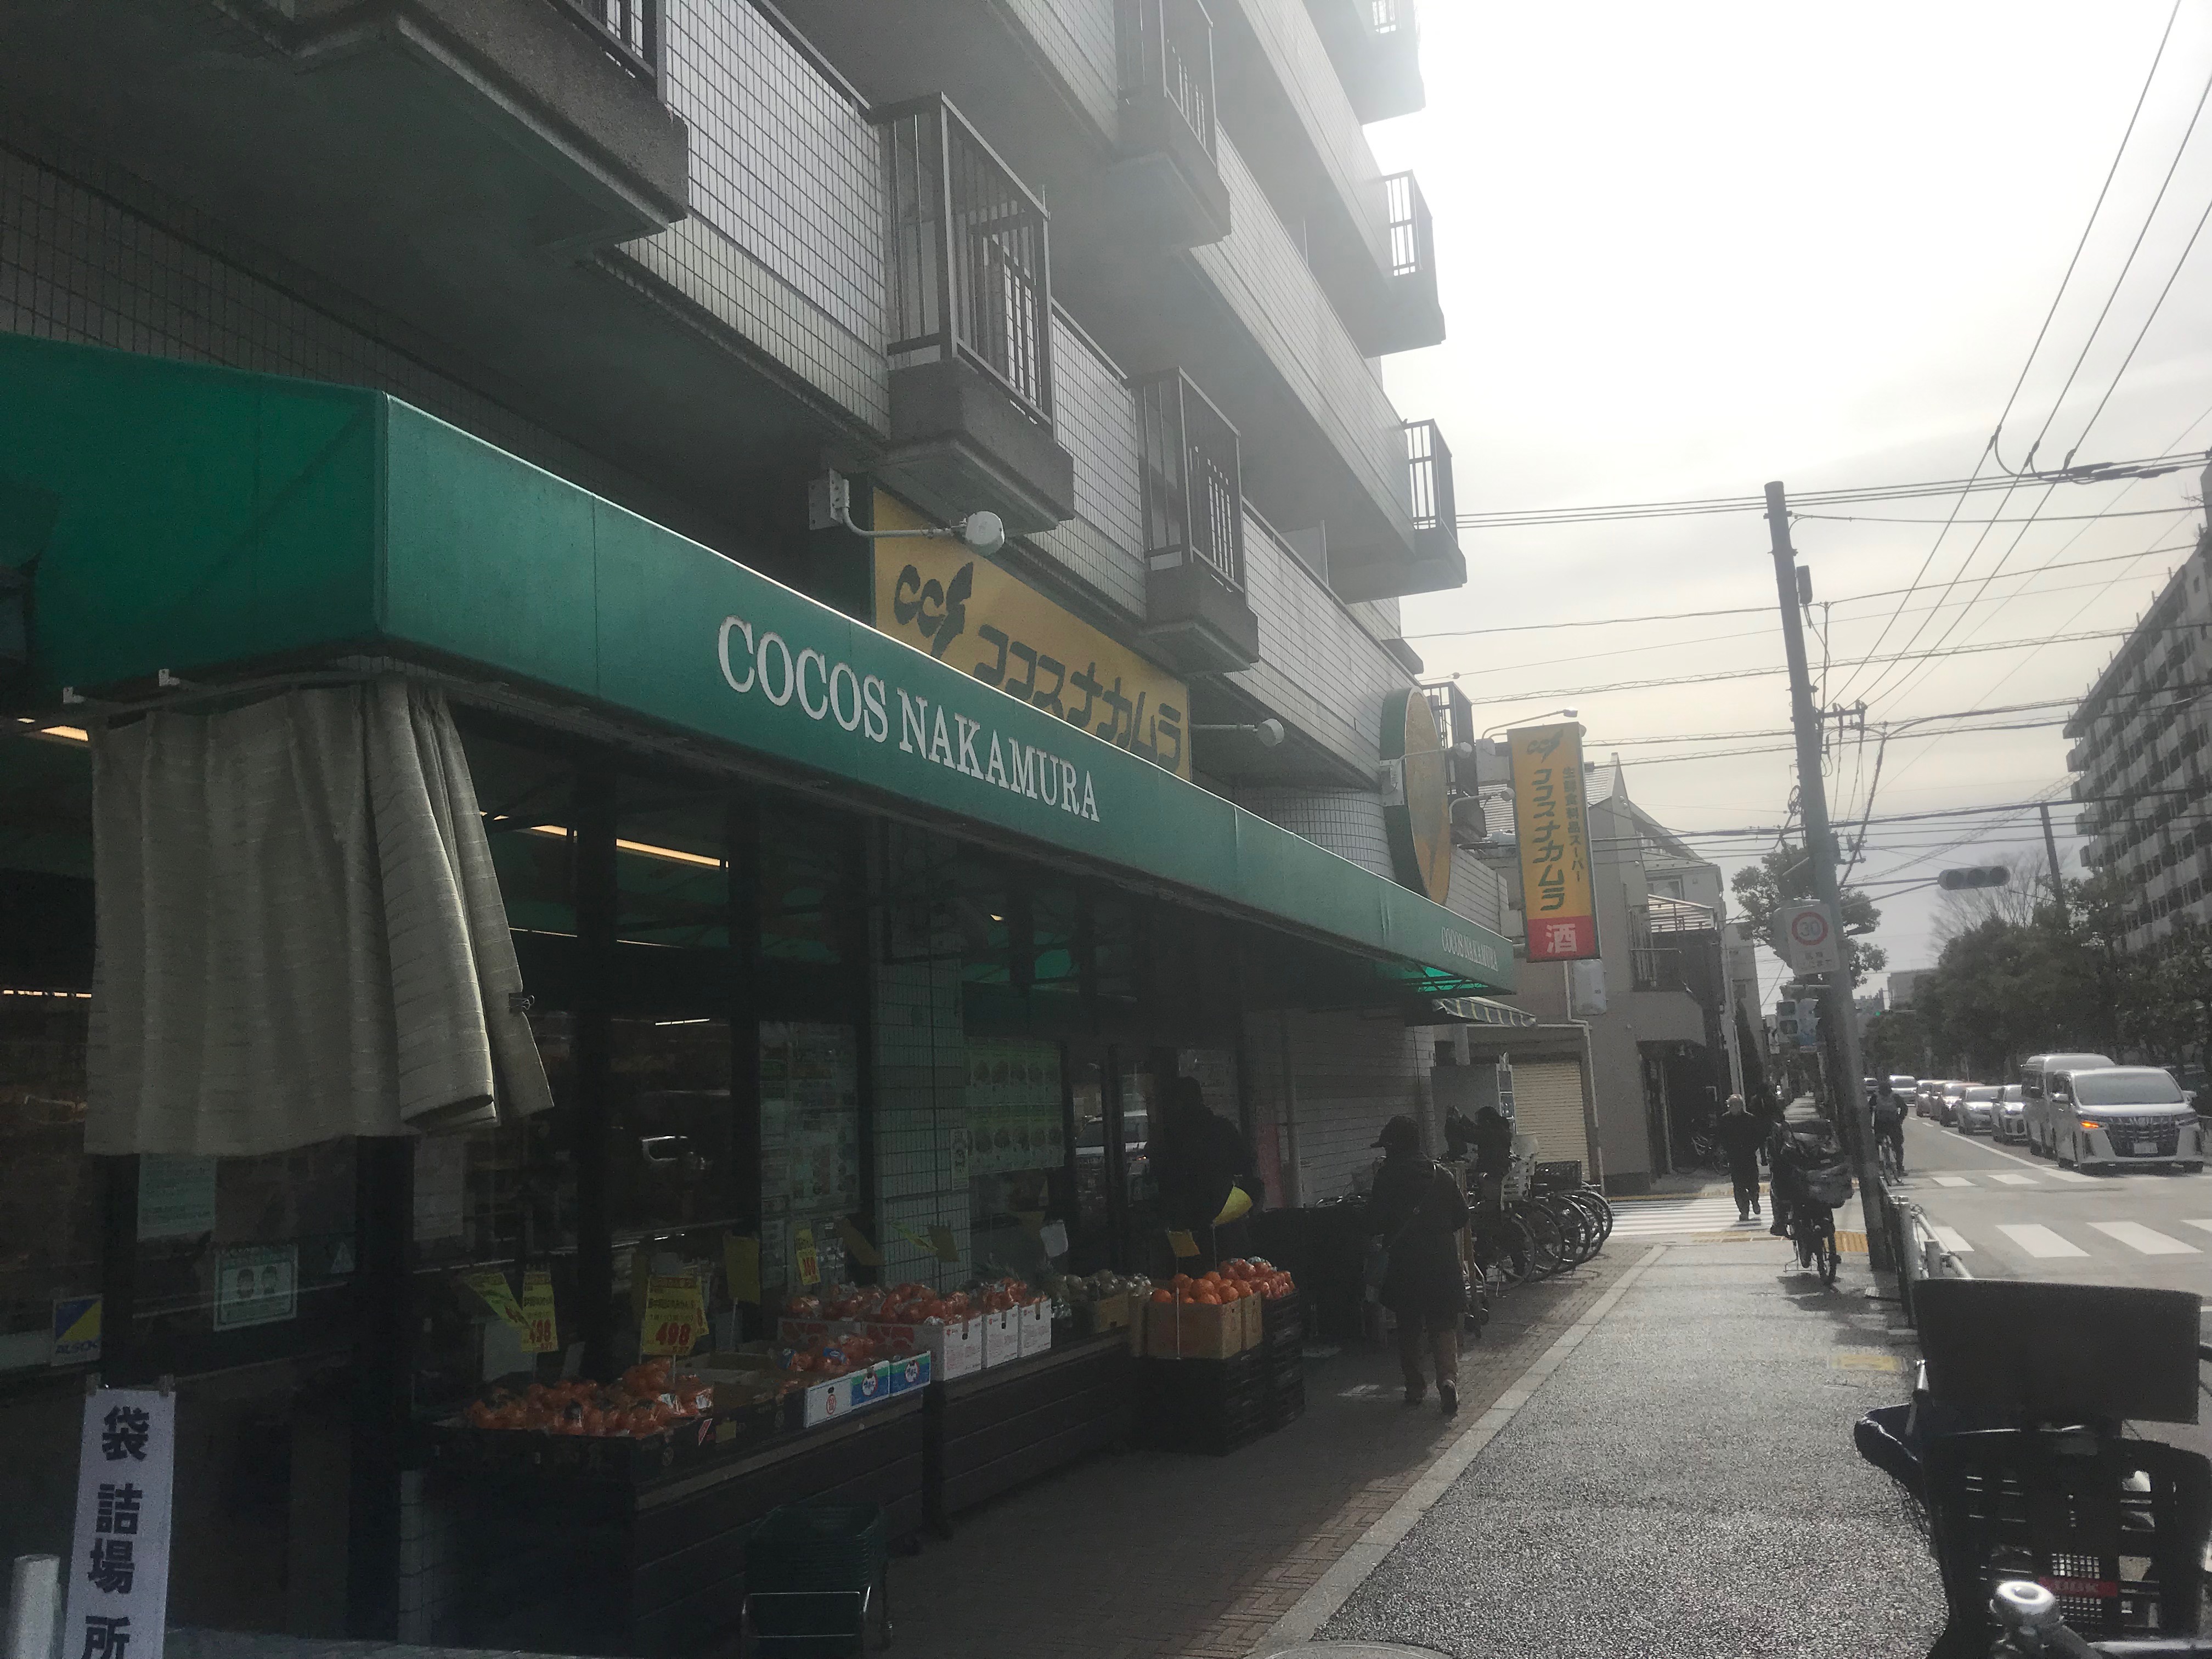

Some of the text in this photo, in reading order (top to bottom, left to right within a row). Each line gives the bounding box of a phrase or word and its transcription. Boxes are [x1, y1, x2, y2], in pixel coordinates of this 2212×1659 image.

[718, 615, 1100, 822] COCOS NAKAMURA
[973, 624, 1181, 774] ココスナカムラ
[1532, 768, 1565, 911] ココスナカムラ
[1546, 923, 1577, 953] 酒
[1800, 921, 1821, 936] 30
[81, 1406, 149, 1659] 袋詰場所
